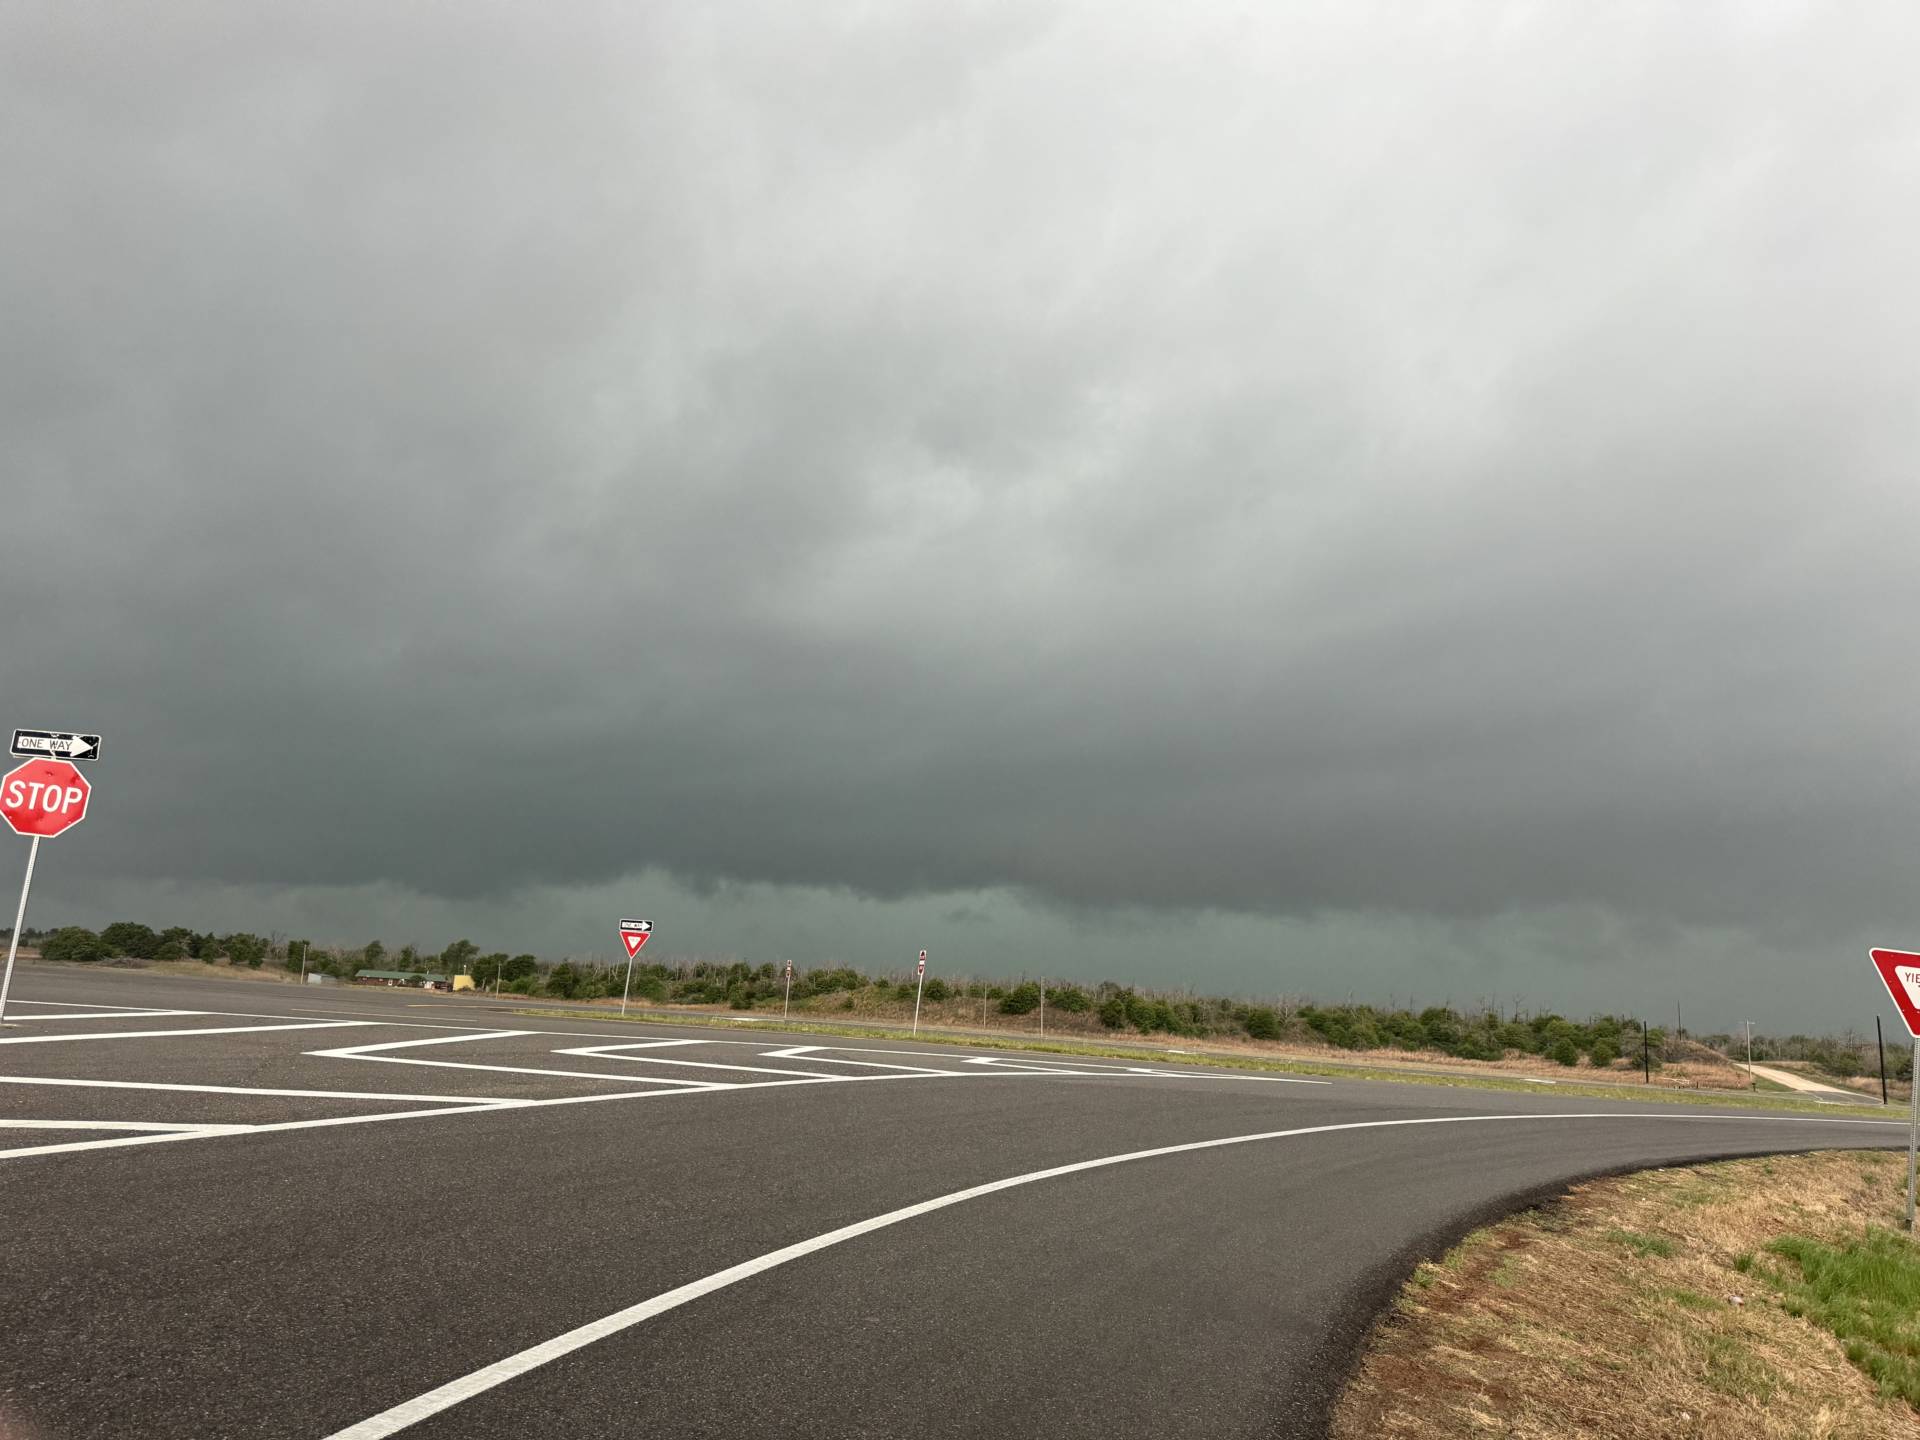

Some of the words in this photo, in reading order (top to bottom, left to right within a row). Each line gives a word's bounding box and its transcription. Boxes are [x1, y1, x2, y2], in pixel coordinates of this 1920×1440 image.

[21, 737, 44, 748] ONE
[49, 739, 73, 750] WAY
[5, 780, 83, 814] STOP
